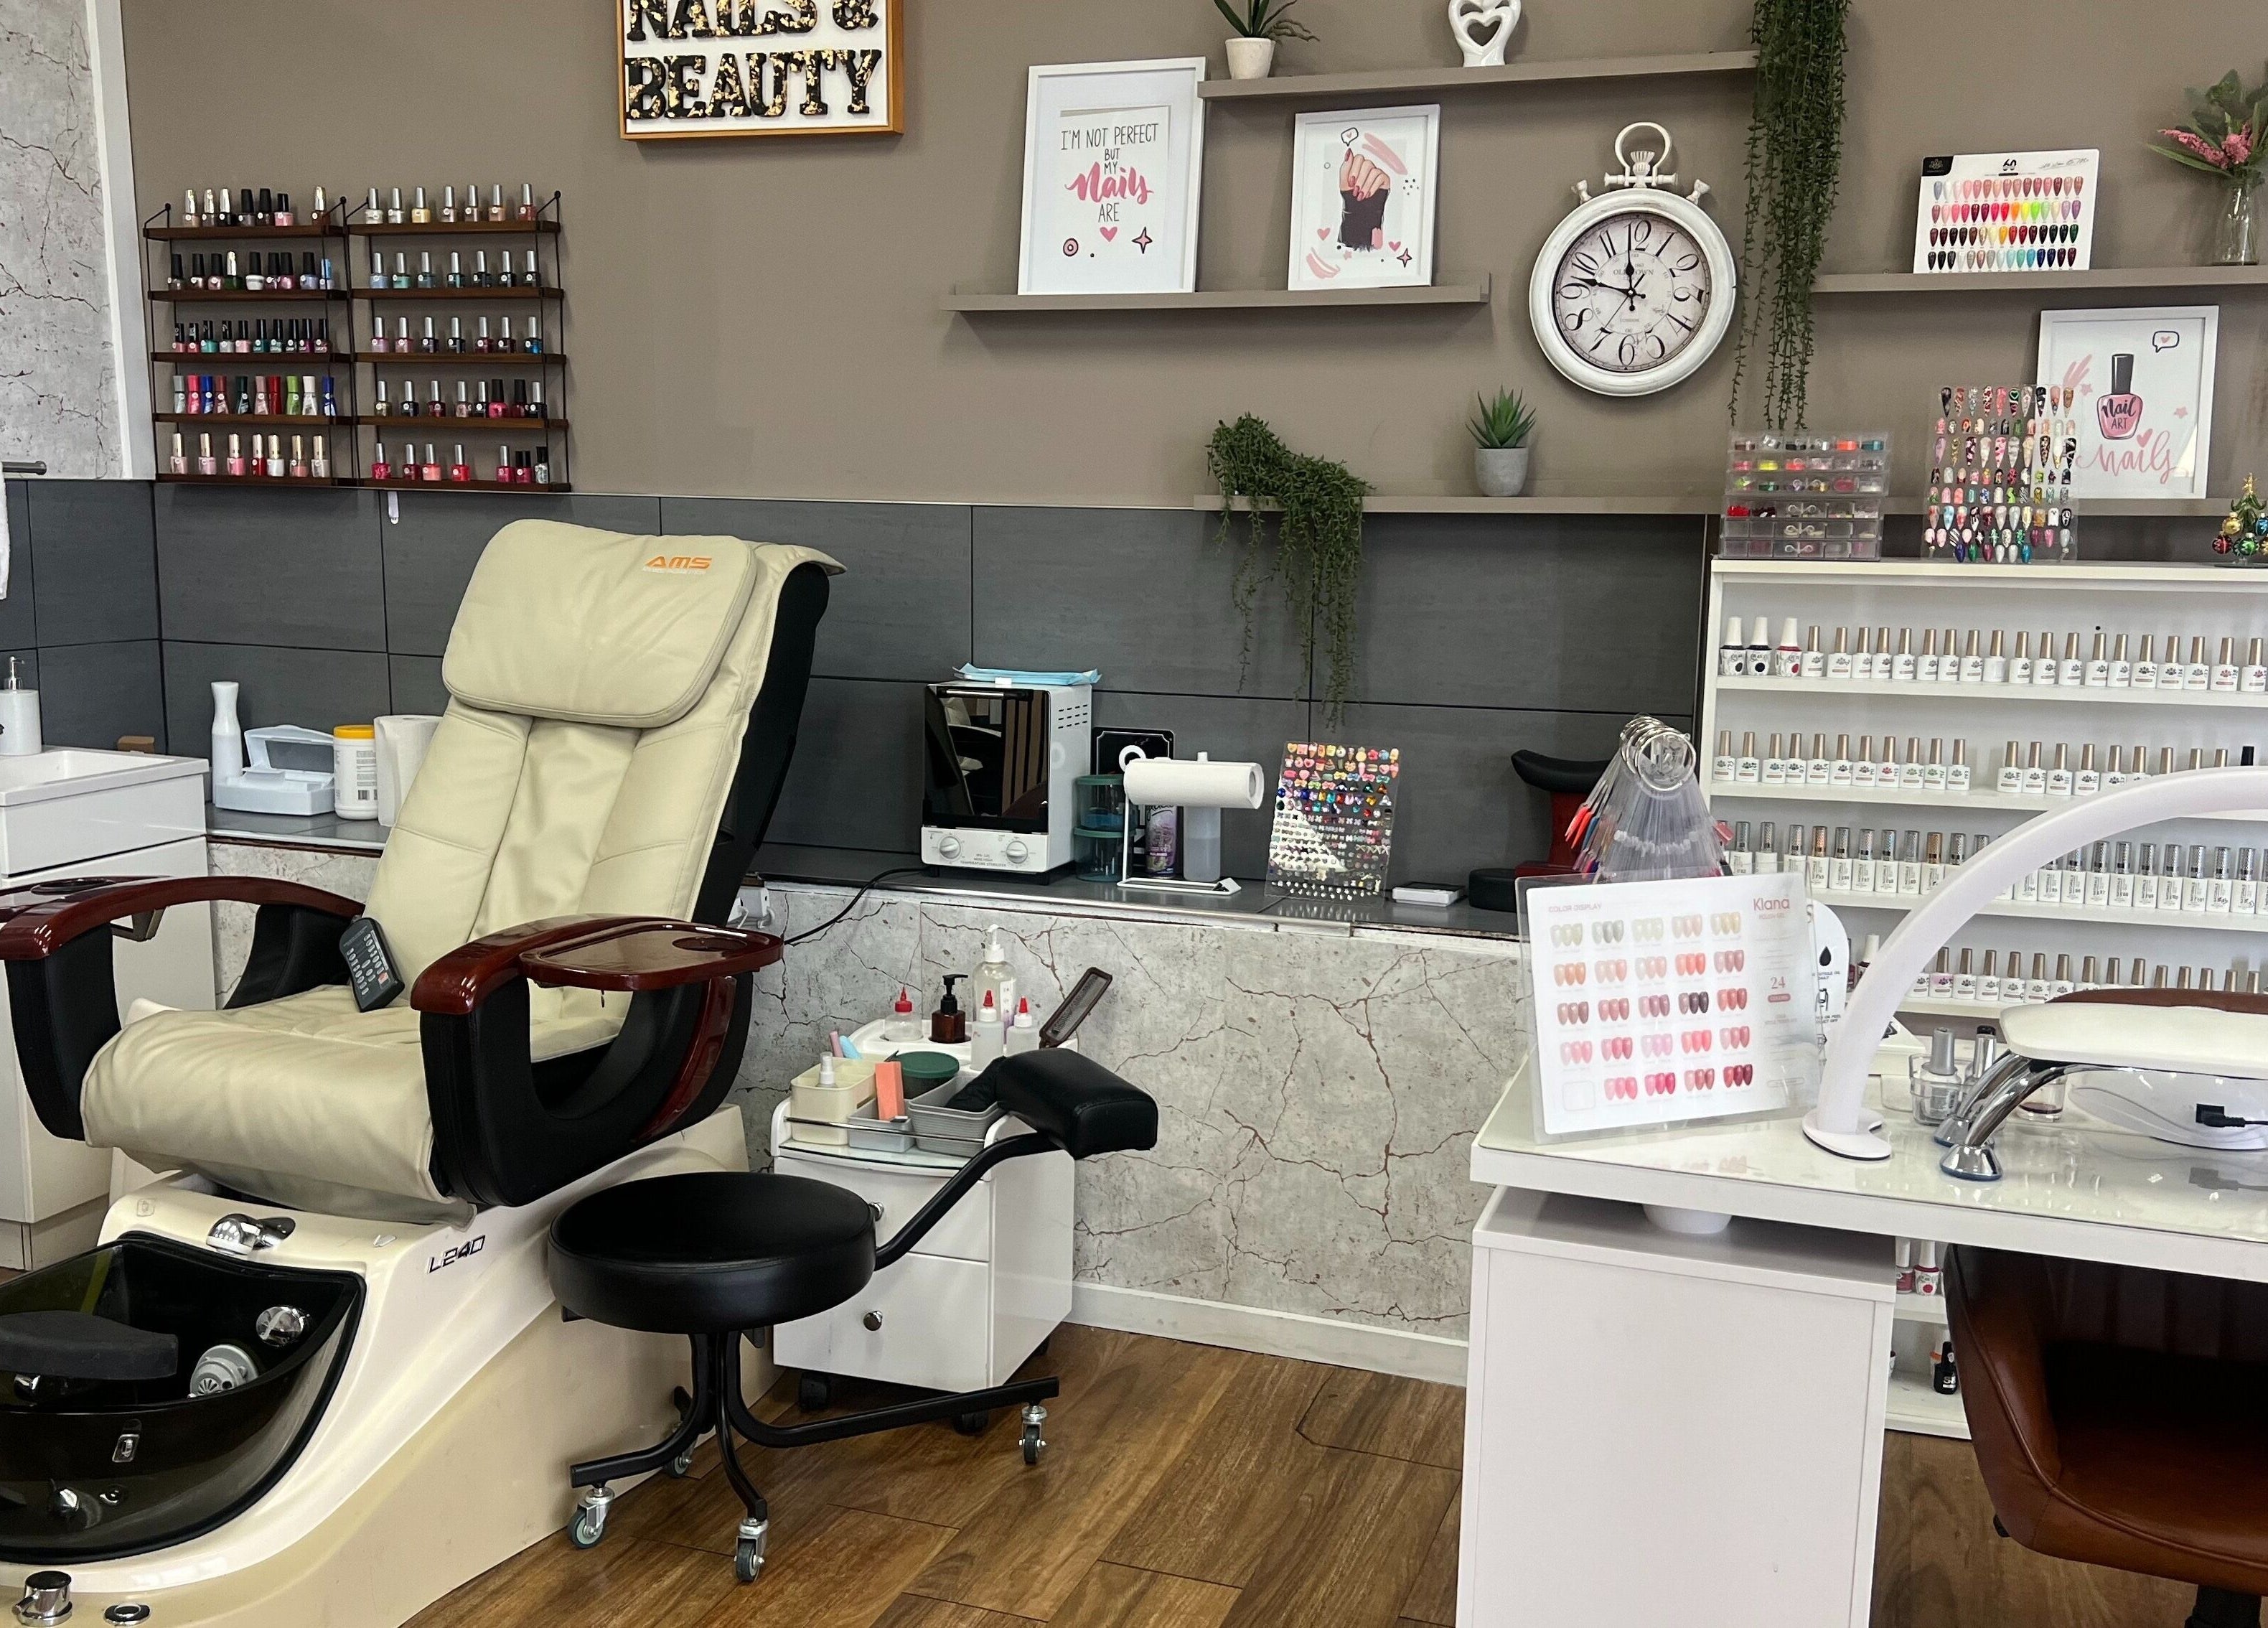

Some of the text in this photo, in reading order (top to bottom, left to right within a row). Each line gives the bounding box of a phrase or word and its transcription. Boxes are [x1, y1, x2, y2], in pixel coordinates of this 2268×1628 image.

[626, 0, 817, 41] NAILS
[624, 49, 882, 120] BEAUTY
[1061, 123, 1158, 151] I'M NOT PERFECT
[1104, 147, 1121, 161] BUT
[1104, 162, 1119, 175] MY
[1064, 161, 1154, 205] Nails
[1097, 202, 1120, 223] ARE
[1624, 220, 1651, 252] 12
[1655, 231, 1677, 258] 1
[1571, 252, 1600, 276] 10
[1669, 253, 1700, 278] 2
[1560, 282, 1591, 300] 9
[1674, 283, 1705, 304] 3
[1565, 307, 1593, 332] 8
[1666, 313, 1694, 337] 4
[1588, 327, 1613, 353] 7
[1618, 334, 1637, 368] 6
[1645, 328, 1666, 360] 5
[2101, 396, 2137, 418] Nail
[2111, 418, 2127, 430] ART
[645, 556, 713, 569] AMS
[1770, 976, 1786, 989] 24
[428, 1235, 486, 1273] L240
